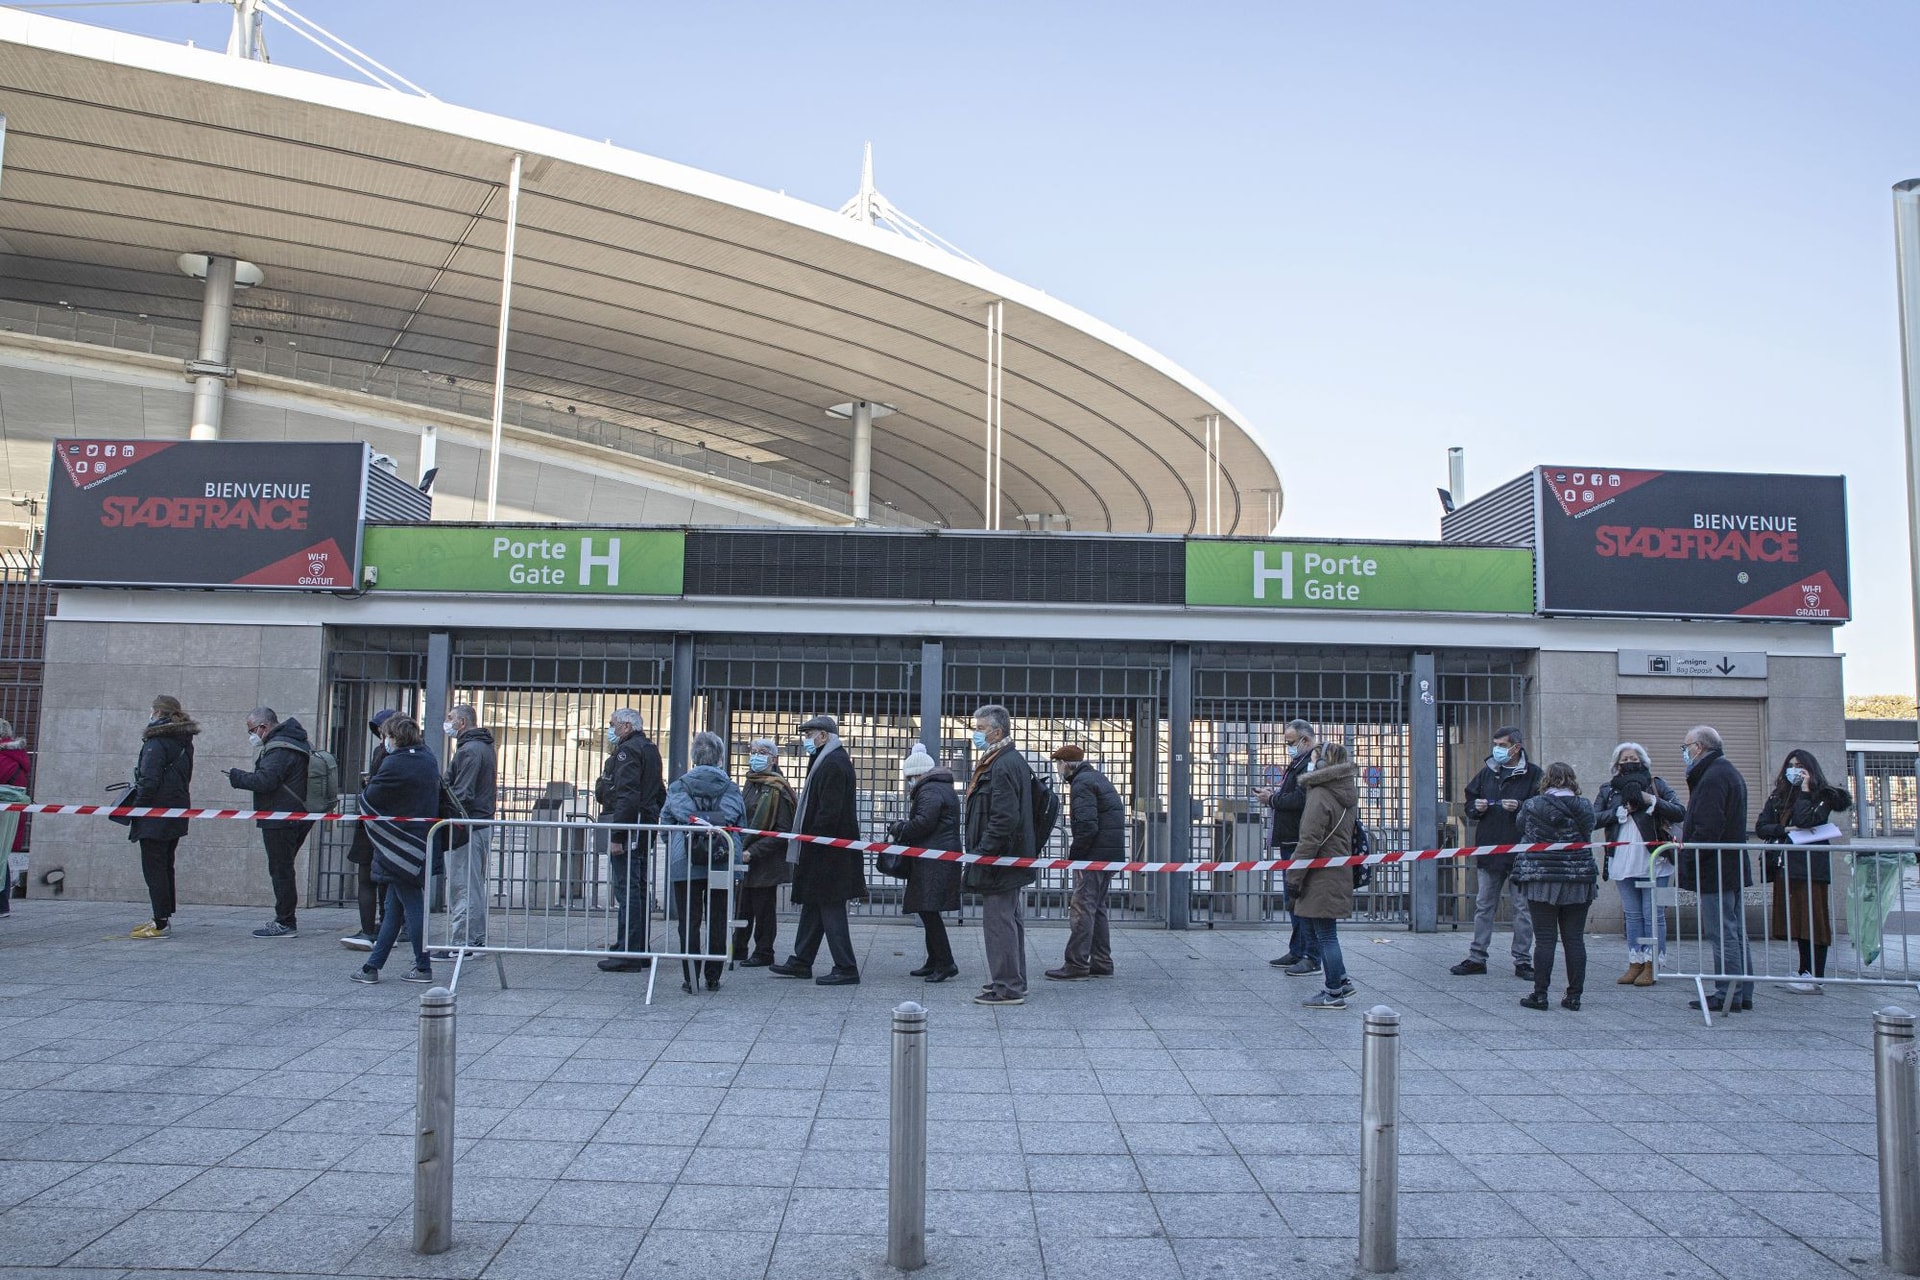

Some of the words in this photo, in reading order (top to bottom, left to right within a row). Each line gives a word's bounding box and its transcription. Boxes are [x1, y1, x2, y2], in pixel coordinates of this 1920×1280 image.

[204, 482, 311, 499] BIENVENUE
[1694, 513, 1797, 532] BIENVENUE
[307, 553, 328, 561] WI-FI
[493, 537, 567, 560] Porte
[579, 537, 621, 586] H
[1304, 553, 1377, 576] Porte
[298, 576, 334, 585] GRATUIT
[509, 563, 565, 585] Gate
[1253, 550, 1293, 600] H
[1304, 579, 1360, 600] Gate
[1801, 585, 1821, 593] WI-FI
[1795, 608, 1831, 617] GRATUIT
